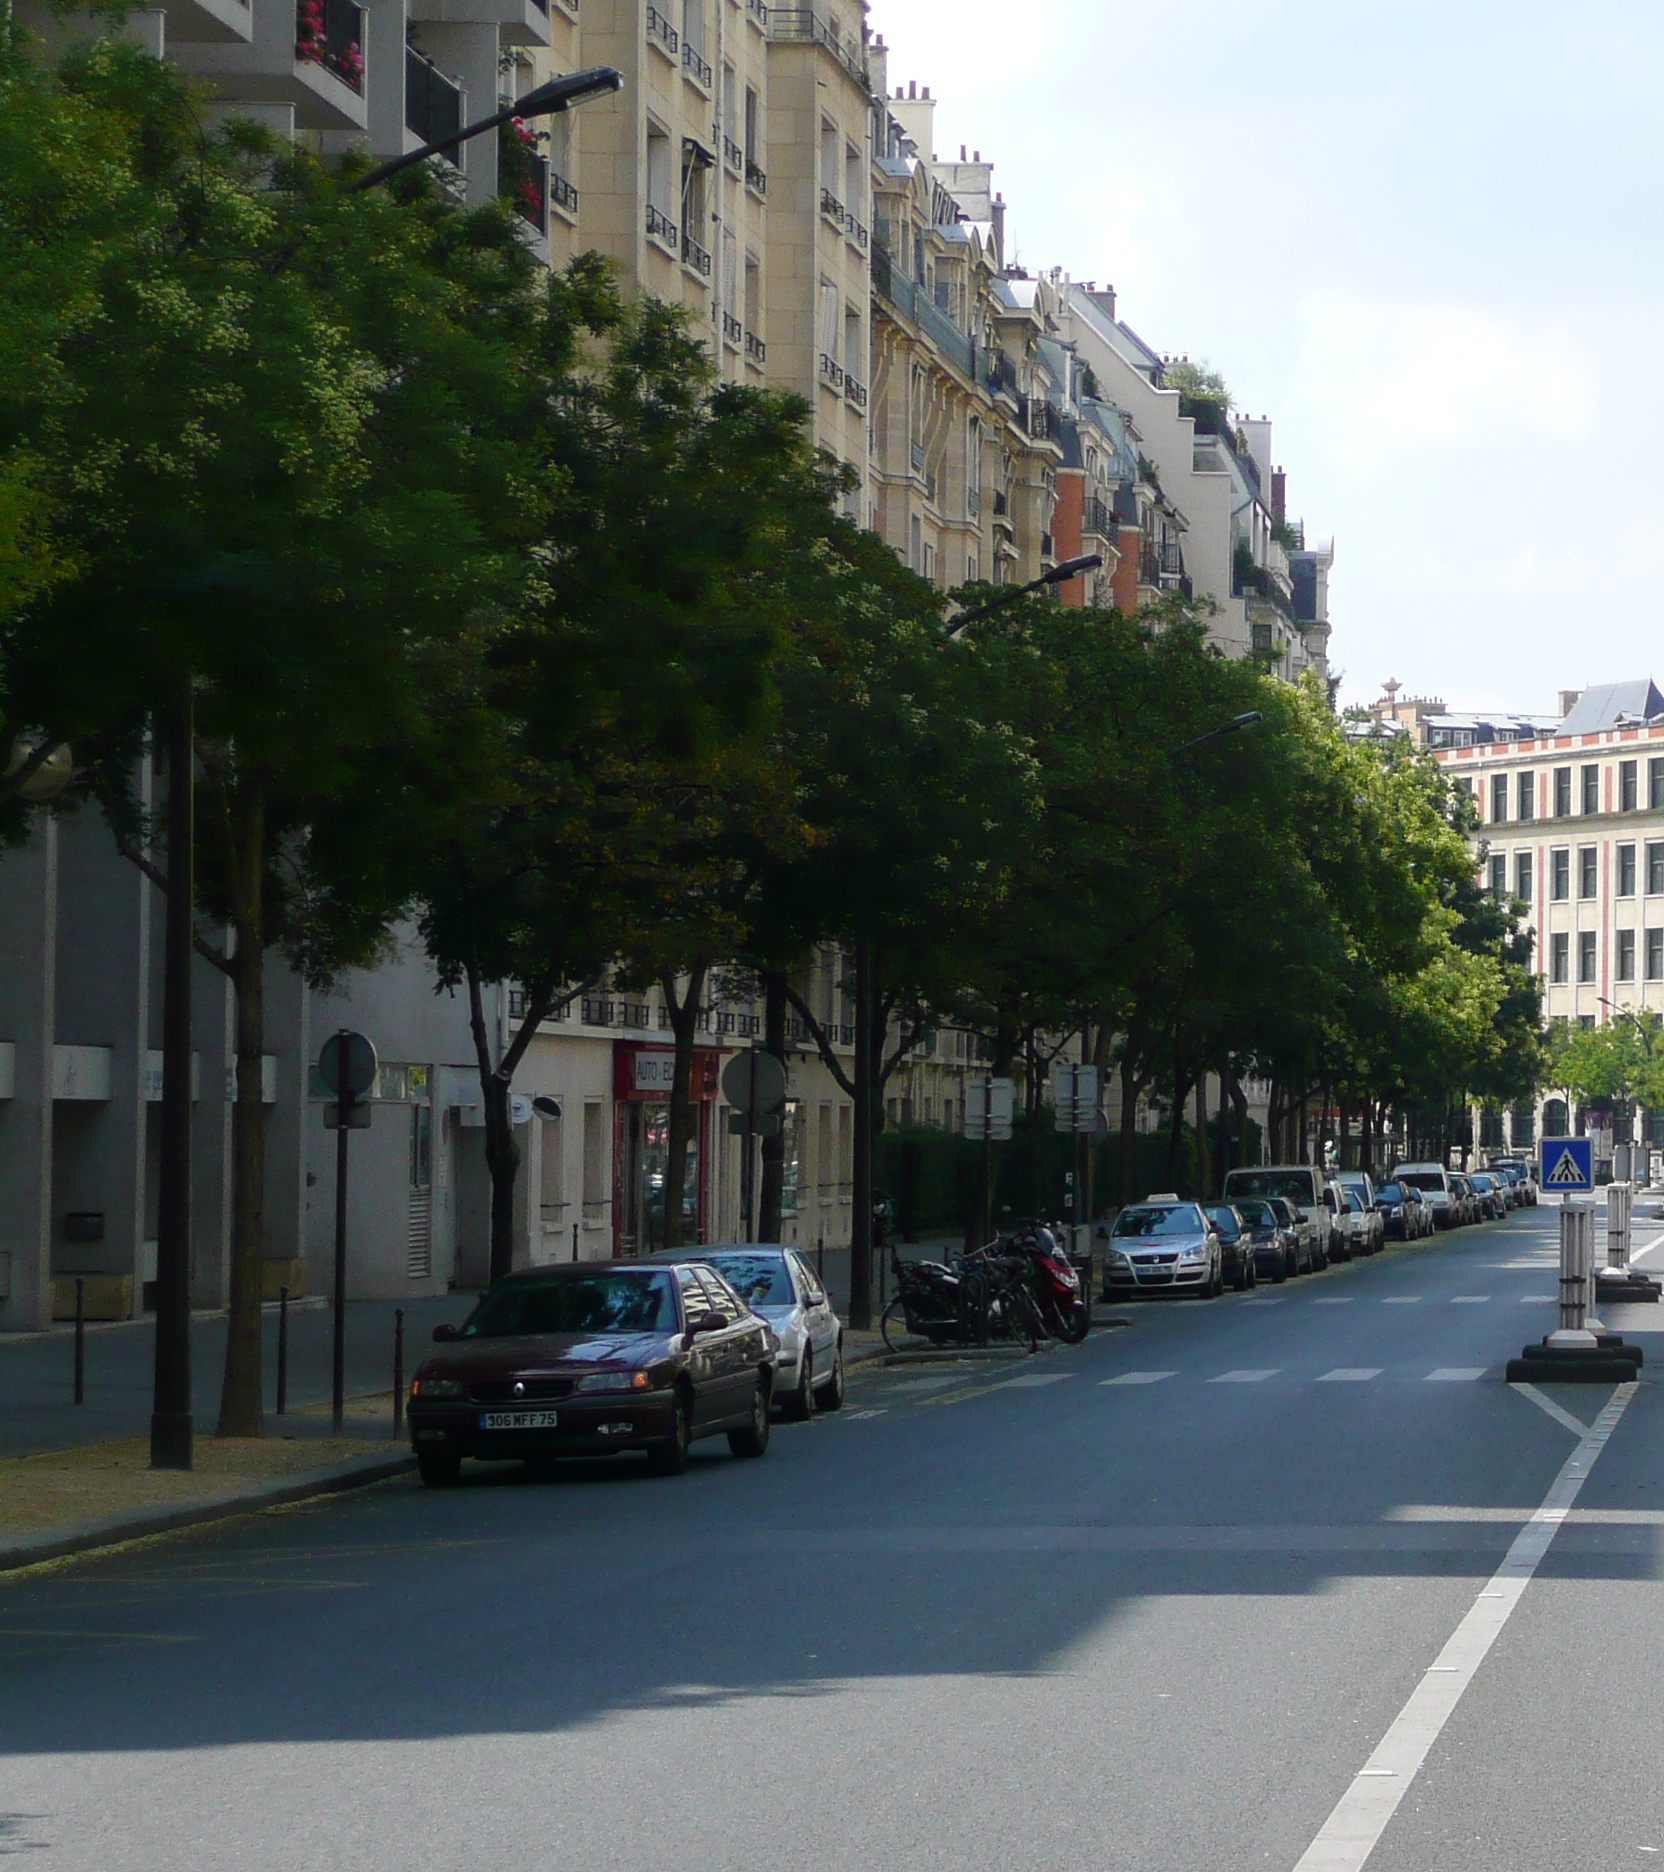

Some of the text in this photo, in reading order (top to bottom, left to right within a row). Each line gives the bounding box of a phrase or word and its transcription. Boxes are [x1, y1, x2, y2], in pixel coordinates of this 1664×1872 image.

[487, 1413, 555, 1427] 306 MFF 75
